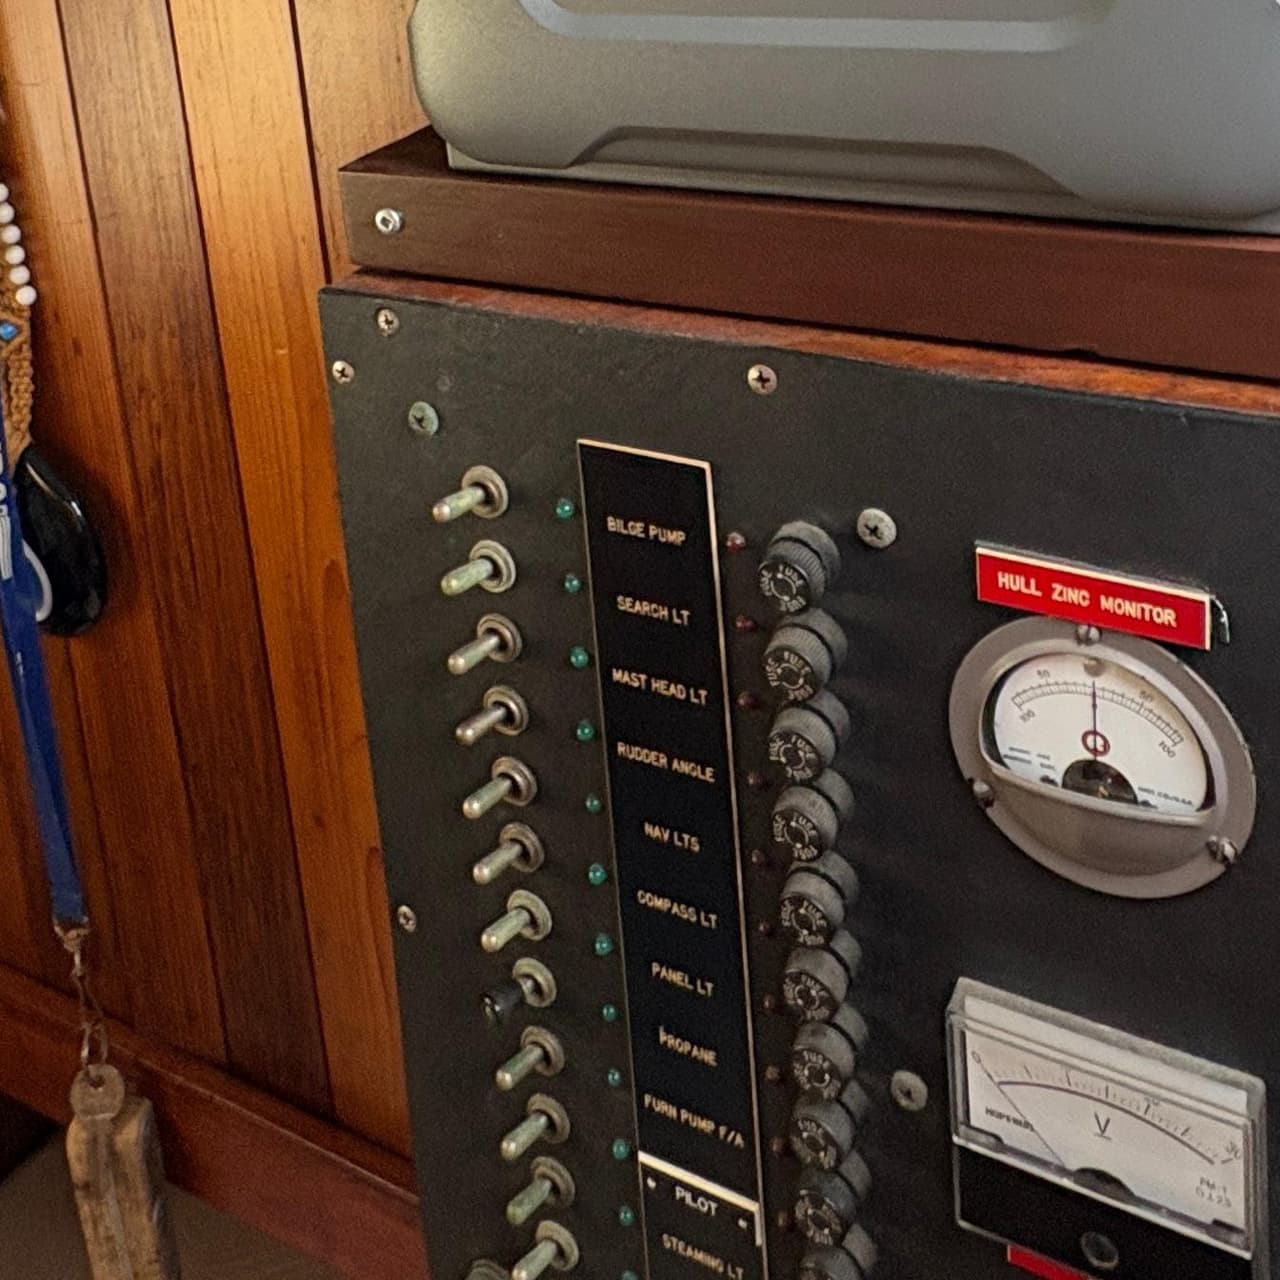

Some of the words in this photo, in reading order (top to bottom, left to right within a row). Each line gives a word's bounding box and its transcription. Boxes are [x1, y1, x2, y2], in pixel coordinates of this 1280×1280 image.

[607, 516, 645, 538] BILGE
[649, 524, 686, 547] PUMP
[616, 595, 669, 621] SEARCH
[672, 608, 691, 626] LT
[997, 571, 1043, 597] HULL
[1051, 583, 1090, 607] ZINC
[1099, 595, 1178, 628] MONITOR
[612, 668, 648, 691] MAST
[651, 677, 686, 700] HEAD
[690, 687, 708, 706] LT
[617, 742, 669, 769] RUDDER
[672, 757, 716, 783] ANGLE
[644, 821, 670, 843] NAV
[673, 831, 701, 853] LTS
[637, 889, 697, 923] COMPASS
[700, 912, 718, 929] LT
[651, 962, 694, 991] PANEL
[696, 979, 714, 998] LT
[658, 1024, 718, 1067] PROPANE
[680, 1108, 716, 1135] PUMP
[675, 1186, 719, 1216] PILOT
[662, 1232, 725, 1273] STEAMING
[727, 1262, 744, 1280] LT
